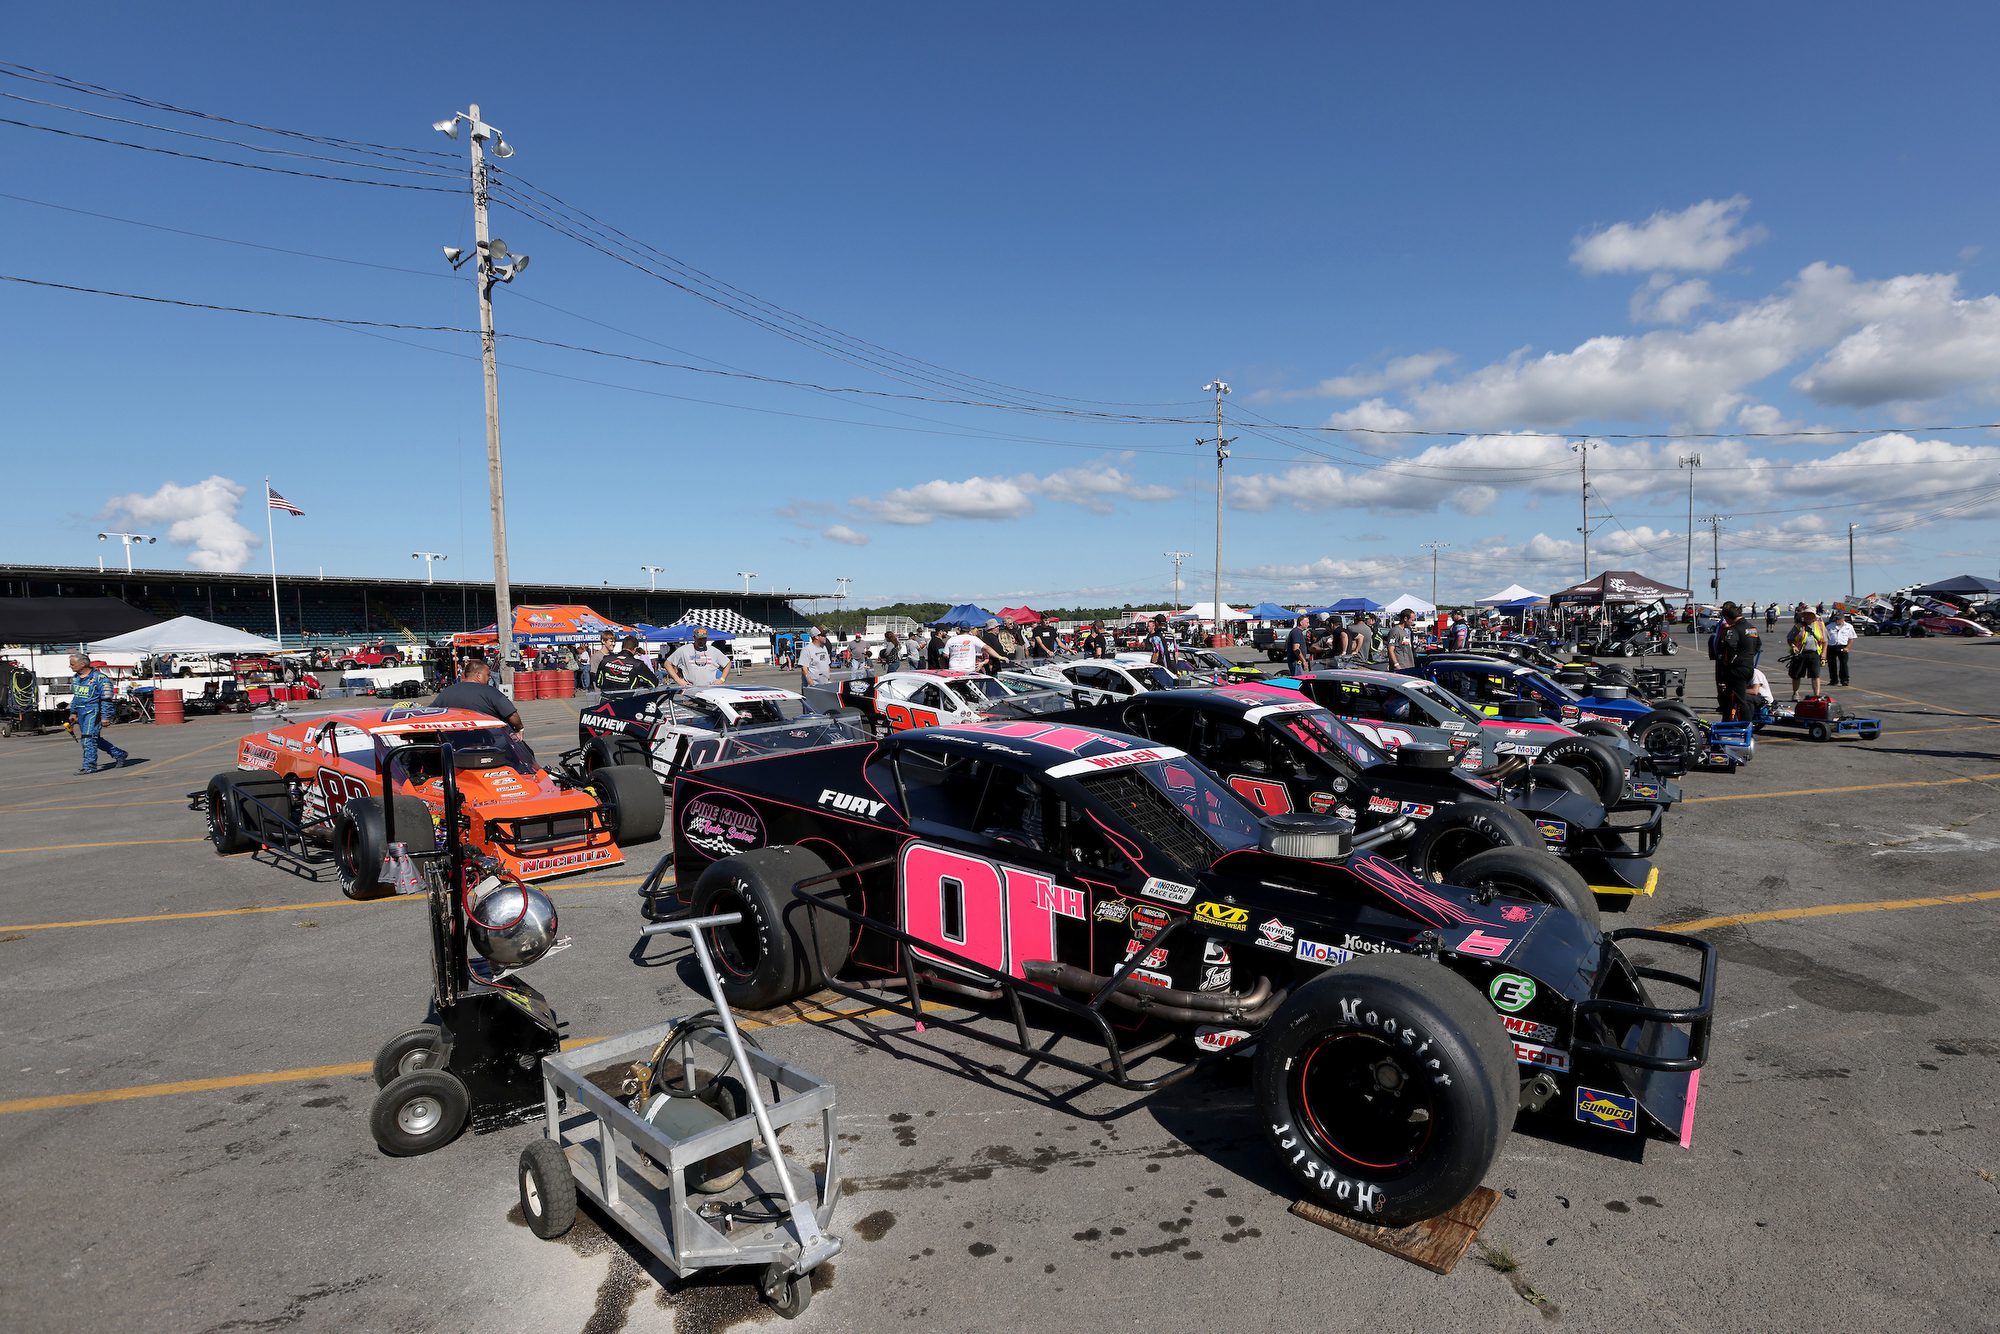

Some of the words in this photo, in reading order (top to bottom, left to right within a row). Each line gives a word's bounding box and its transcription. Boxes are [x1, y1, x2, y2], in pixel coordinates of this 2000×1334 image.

[409, 720, 477, 730] WHELEN
[580, 713, 627, 732] MAYHEW
[1087, 749, 1163, 770] WHELEN
[1543, 742, 1590, 765] Hoosier
[818, 788, 887, 818] FURY
[1368, 805, 1394, 814] MSD
[1370, 796, 1399, 810] Holley
[1402, 803, 1431, 816] JE
[690, 800, 720, 822] PINE
[719, 807, 758, 833] KNOLL
[701, 819, 725, 836] Auto
[1537, 826, 1565, 836] SUNOCO
[1148, 887, 1169, 897] RACE
[1168, 892, 1184, 901] CAR
[1153, 880, 1189, 895] NASCAR
[1100, 901, 1127, 914] RACING
[1132, 912, 1169, 927] WHELEN
[1193, 913, 1227, 928] MECHANIX
[1227, 922, 1247, 932] WEAR
[1260, 923, 1293, 938] MAYHEW
[1126, 939, 1169, 961] Hoey
[1300, 941, 1348, 964] Mobil
[1339, 997, 1452, 1086] Hoosier
[1514, 1043, 1565, 1068] ton
[1578, 1100, 1633, 1121] SUNOCO
[1272, 1123, 1383, 1214] Hoosier
